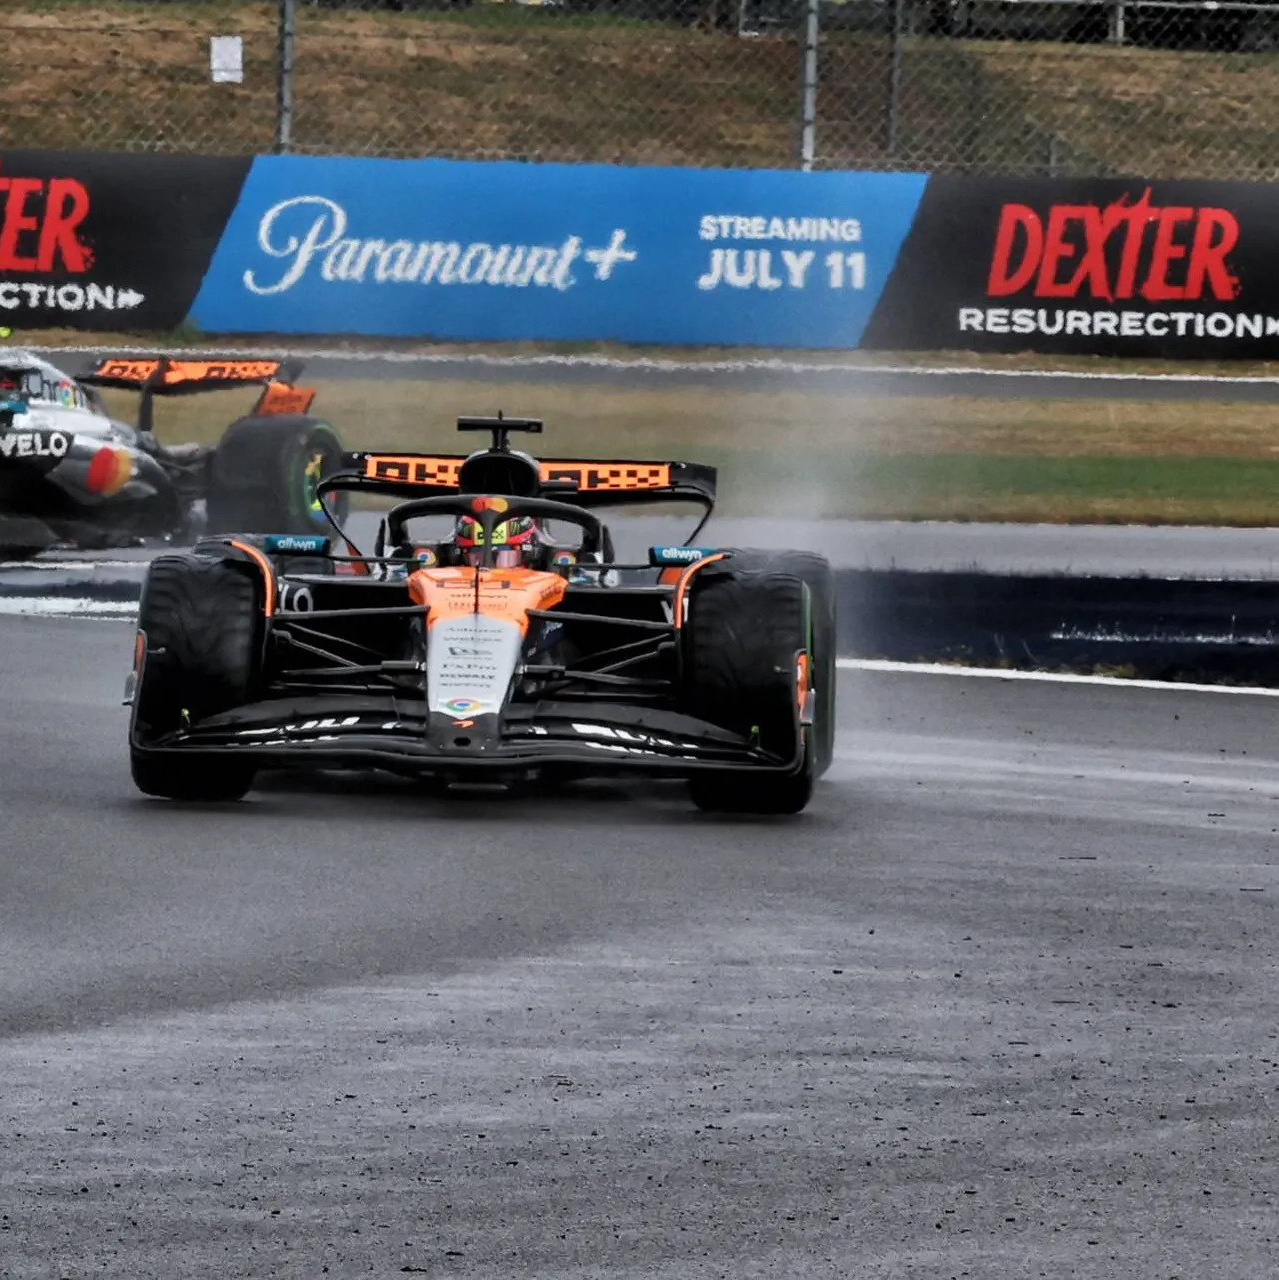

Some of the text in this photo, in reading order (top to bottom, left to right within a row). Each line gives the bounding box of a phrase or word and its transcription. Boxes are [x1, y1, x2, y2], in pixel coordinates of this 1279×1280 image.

[243, 196, 637, 295] Paramount+
[700, 215, 861, 243] STREAMING
[986, 187, 1241, 302] DEXTER
[698, 249, 866, 290] JULY 11
[959, 308, 1263, 338] RESURRECTION
[662, 548, 703, 561] allwyn
